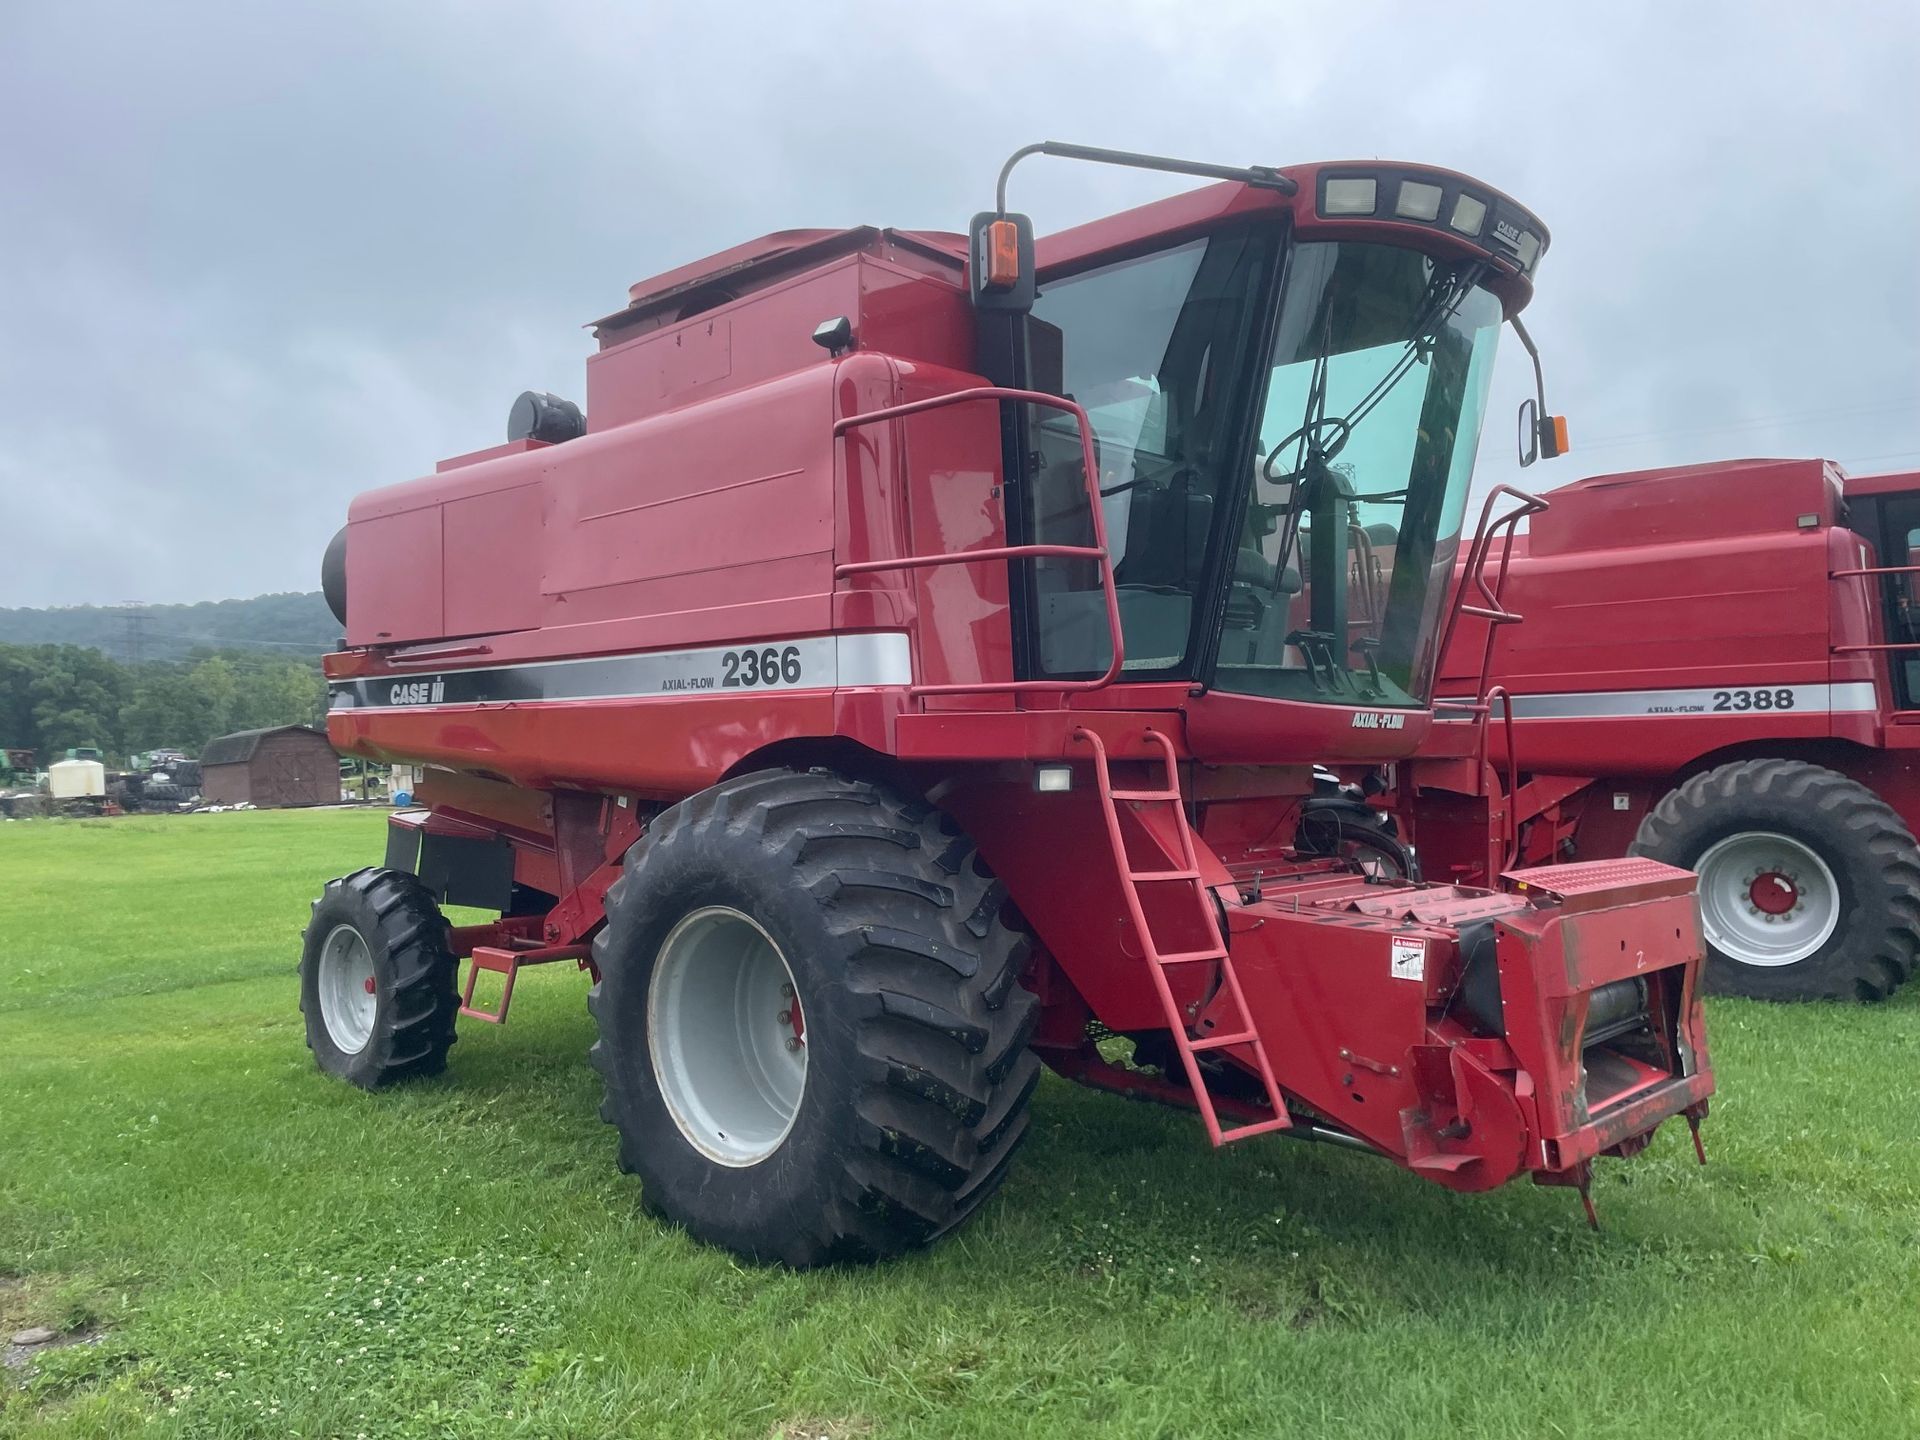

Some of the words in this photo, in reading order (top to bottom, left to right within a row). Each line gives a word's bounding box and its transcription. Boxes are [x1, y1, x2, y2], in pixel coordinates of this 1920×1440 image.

[1497, 220, 1519, 241] CASE
[721, 646, 802, 688] 2366
[390, 683, 429, 705] CASE
[1712, 689, 1795, 712] 2388
